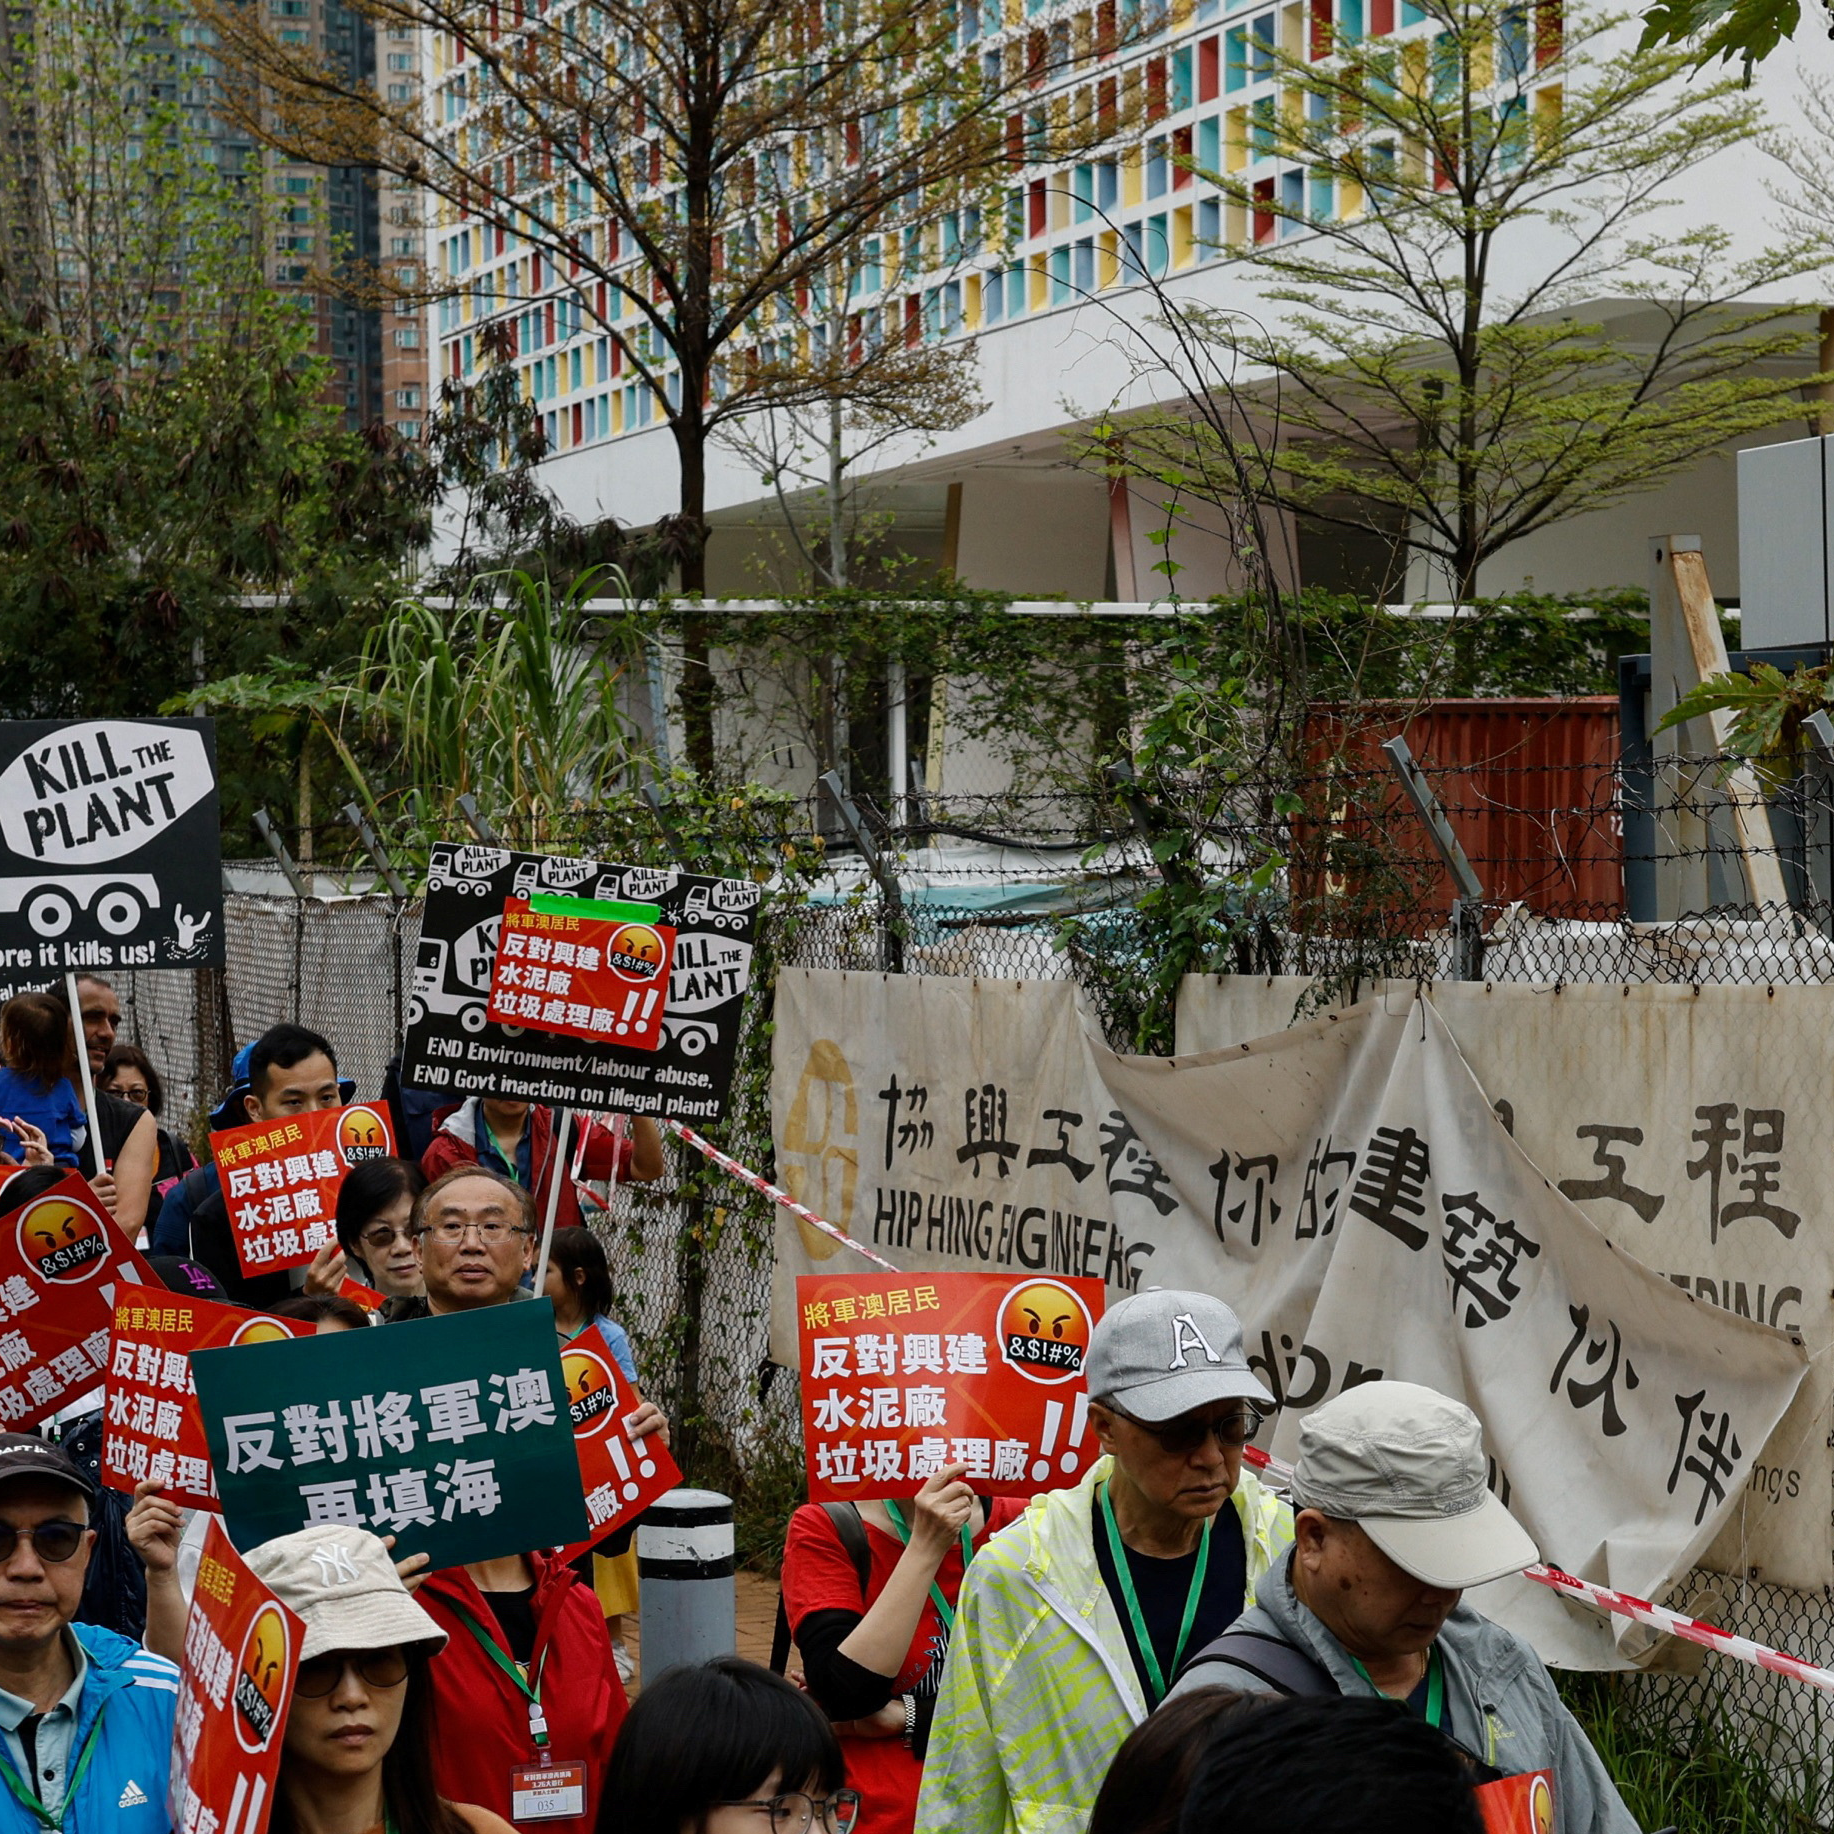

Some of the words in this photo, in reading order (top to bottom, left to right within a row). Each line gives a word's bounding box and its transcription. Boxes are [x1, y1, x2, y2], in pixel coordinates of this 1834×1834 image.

[23, 731, 132, 800] KILL
[133, 739, 175, 770] THE
[24, 773, 175, 857] PLANT
[461, 858, 502, 874] PLANT
[548, 868, 588, 884] PLANT
[629, 876, 668, 895] PLANT
[719, 889, 759, 908] PLANT
[506, 913, 580, 931] 將軍澳居民
[39, 943, 58, 967] it
[64, 941, 113, 967] kills
[120, 940, 156, 965] us!
[503, 934, 600, 972] 反對興建
[719, 948, 743, 962] THE
[499, 962, 572, 995] 水泥廠
[493, 989, 617, 1033] 垃圾處理廠
[427, 1036, 464, 1058] END
[468, 1041, 650, 1079] Environment/labour
[656, 1068, 713, 1090] abuse,
[413, 1064, 450, 1085] END
[454, 1067, 496, 1092] Govt
[501, 1072, 576, 1100] inaction
[580, 1086, 602, 1103] on
[608, 1087, 662, 1112] illegal
[667, 1094, 720, 1118] plant!
[218, 1123, 304, 1168] 將軍澳居民
[228, 1149, 340, 1199] 反對興建
[235, 1188, 324, 1232] 水泥廠
[873, 1187, 923, 1249] HIP
[925, 1194, 995, 1262] HING
[114, 1305, 194, 1334] 將軍澳居民
[804, 1284, 941, 1330] 將軍澳居民
[810, 1332, 988, 1380] 反對興建
[1169, 1312, 1222, 1371] A
[111, 1339, 197, 1396] 反對興
[108, 1387, 184, 1443] 水泥廠
[223, 1367, 558, 1476] 反對將軍澳
[813, 1384, 948, 1433] 水泥廠
[815, 1435, 1030, 1484] 垃圾處理廠
[299, 1458, 503, 1534] 再填海
[118, 1795, 148, 1809] adidas
[537, 1799, 555, 1812] 035
